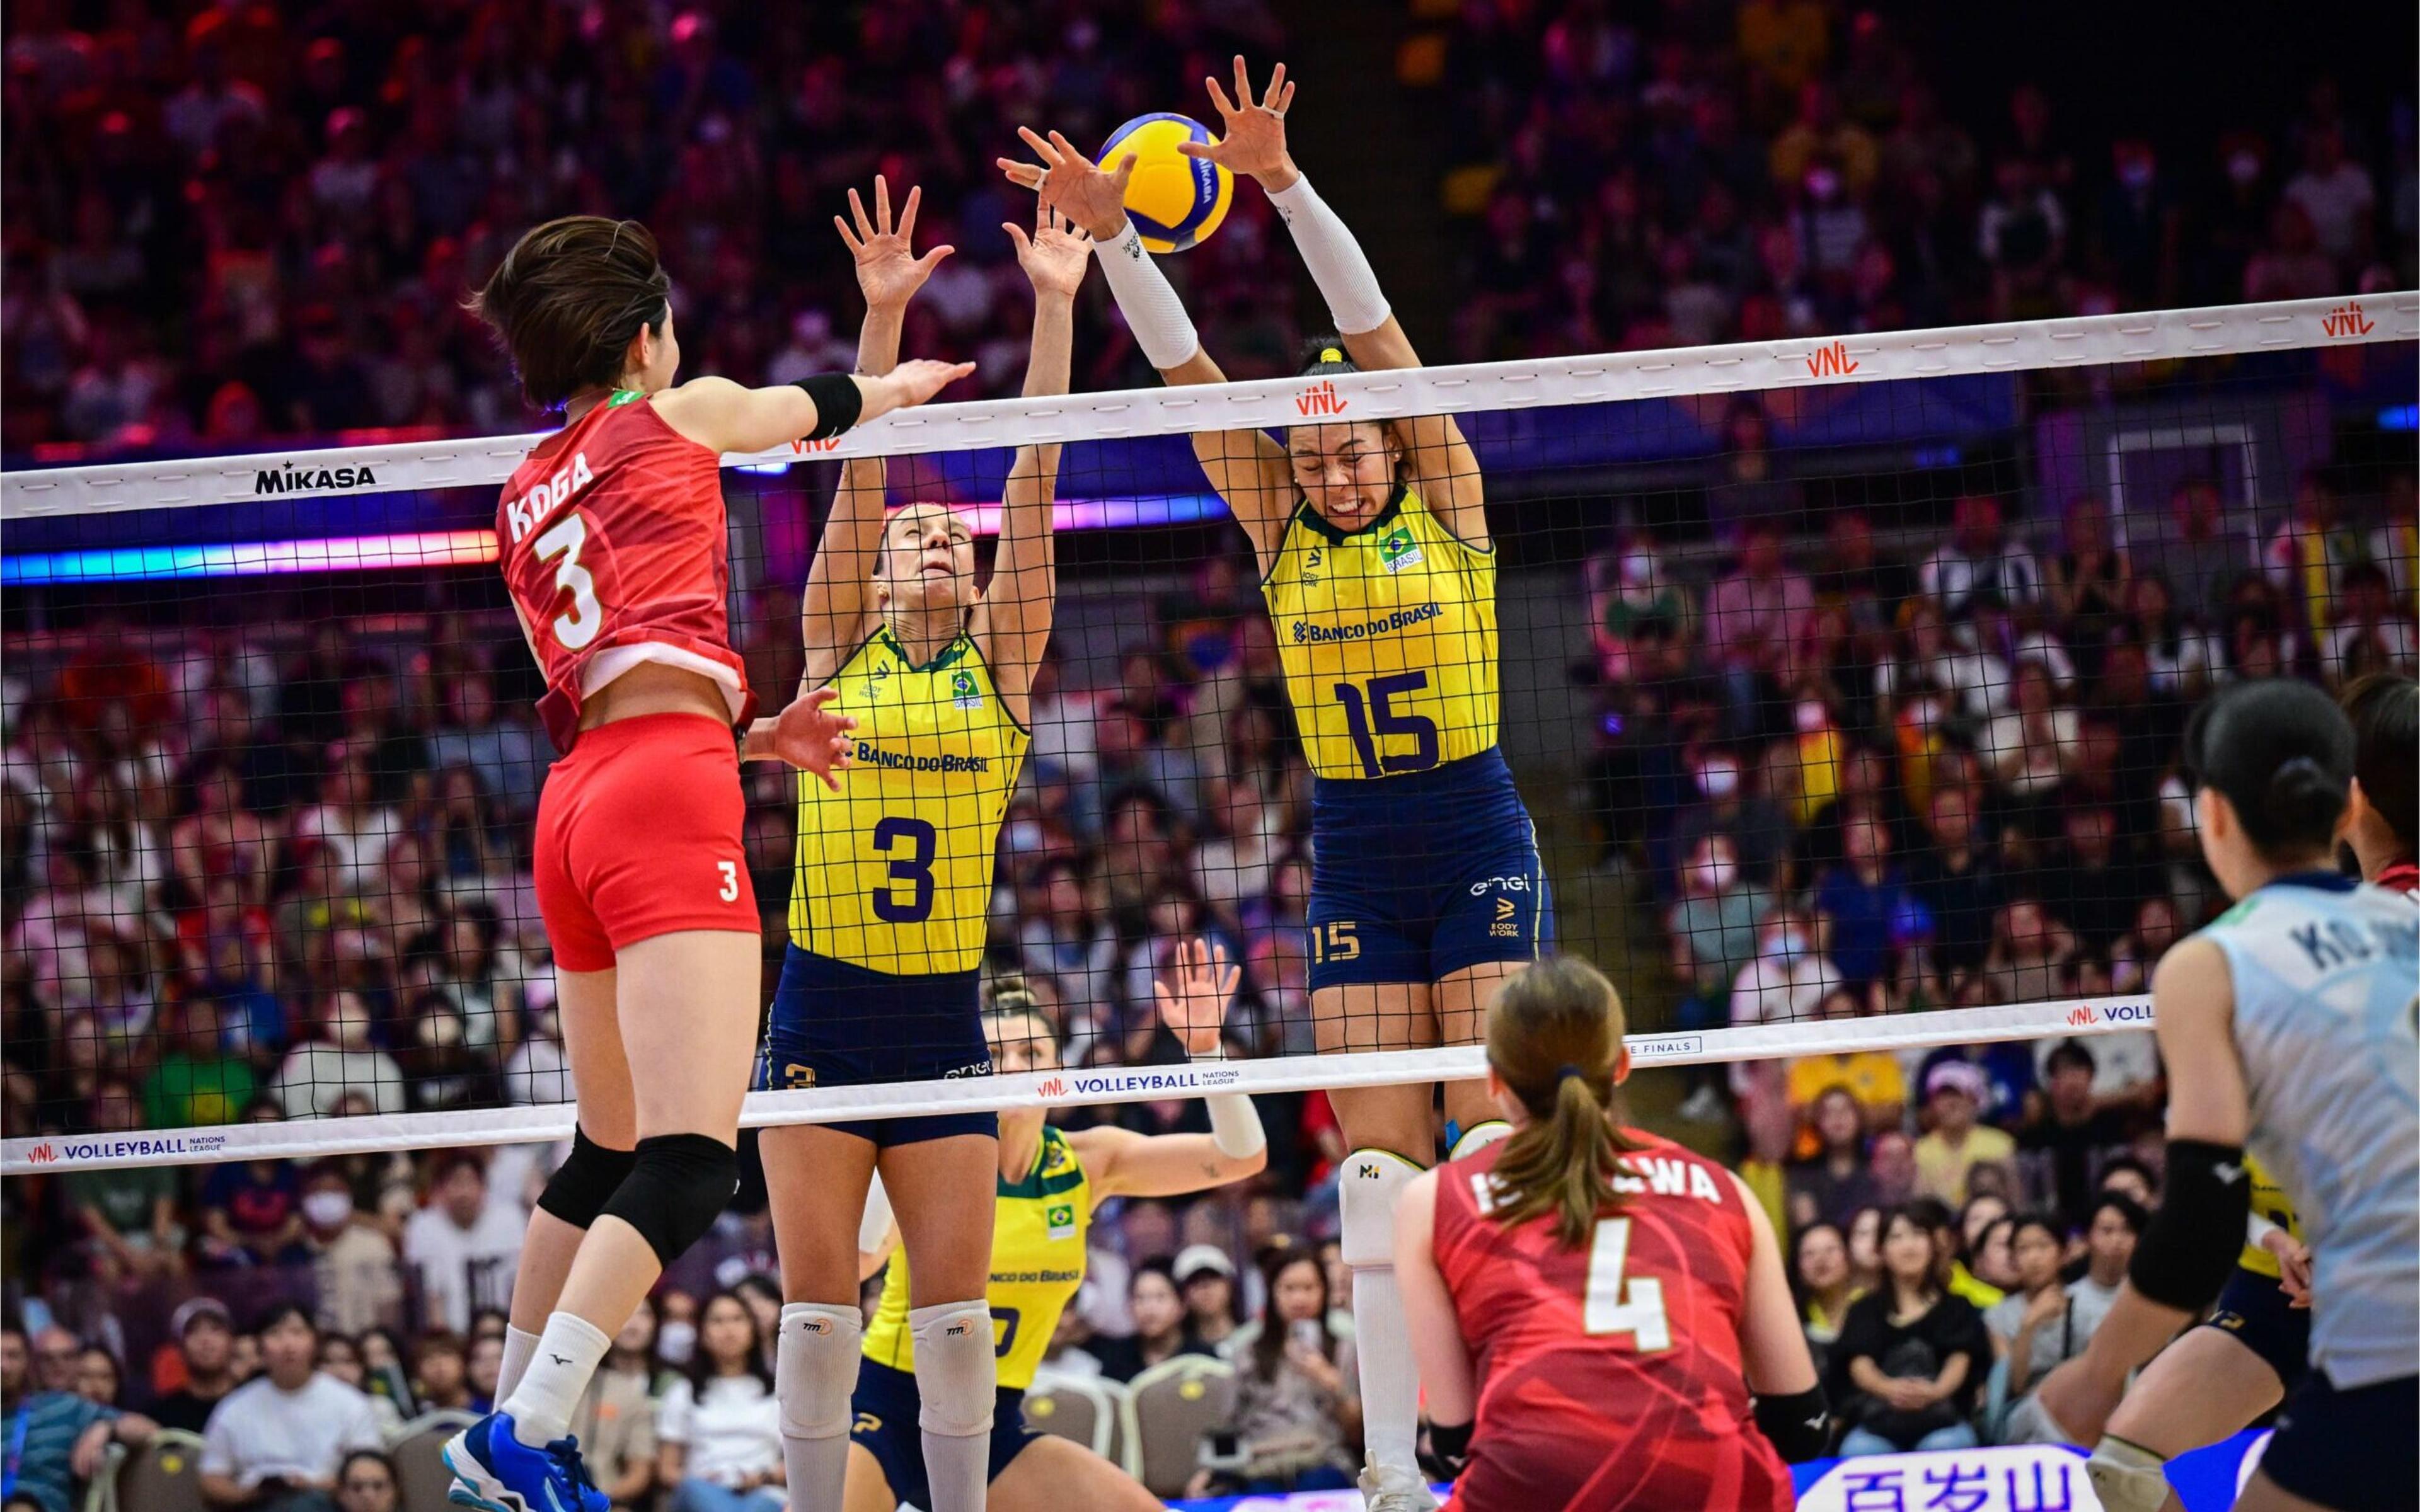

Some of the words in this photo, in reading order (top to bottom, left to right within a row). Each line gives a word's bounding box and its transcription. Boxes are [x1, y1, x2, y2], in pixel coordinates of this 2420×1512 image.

[2322, 302, 2374, 336] VNL
[1807, 341, 1858, 377] VNL
[1296, 381, 1347, 415] VNL
[255, 467, 376, 495] MIKASA
[507, 452, 594, 544] KOGA
[1386, 551, 1422, 572] BRASIL
[534, 513, 602, 650] 3
[1310, 625, 1364, 641] BANCO
[1366, 619, 1388, 635] DO
[1389, 602, 1443, 630] BRASIL
[1334, 670, 1439, 778] 15
[858, 742, 913, 770] BANCO
[917, 757, 940, 772] DO
[942, 754, 988, 772] BRASIL
[717, 861, 739, 902] 3
[873, 816, 936, 922] 3
[1470, 873, 1530, 896] enel
[1312, 921, 1360, 964] 15
[2067, 1005, 2099, 1026] VNL
[1644, 1042, 1691, 1054] FINALS
[1038, 1077, 1068, 1097] VNL
[1075, 1074, 1199, 1094] VOLLEYBALL
[1202, 1070, 1240, 1079] NATIONS
[28, 1143, 57, 1164] VNL
[65, 1139, 186, 1160] VOLLEYBALL
[190, 1136, 226, 1145] NATIONS
[190, 1144, 222, 1152] LEAGUE
[1584, 1217, 1671, 1353] 4
[1843, 1461, 2071, 1512] 百岁山
